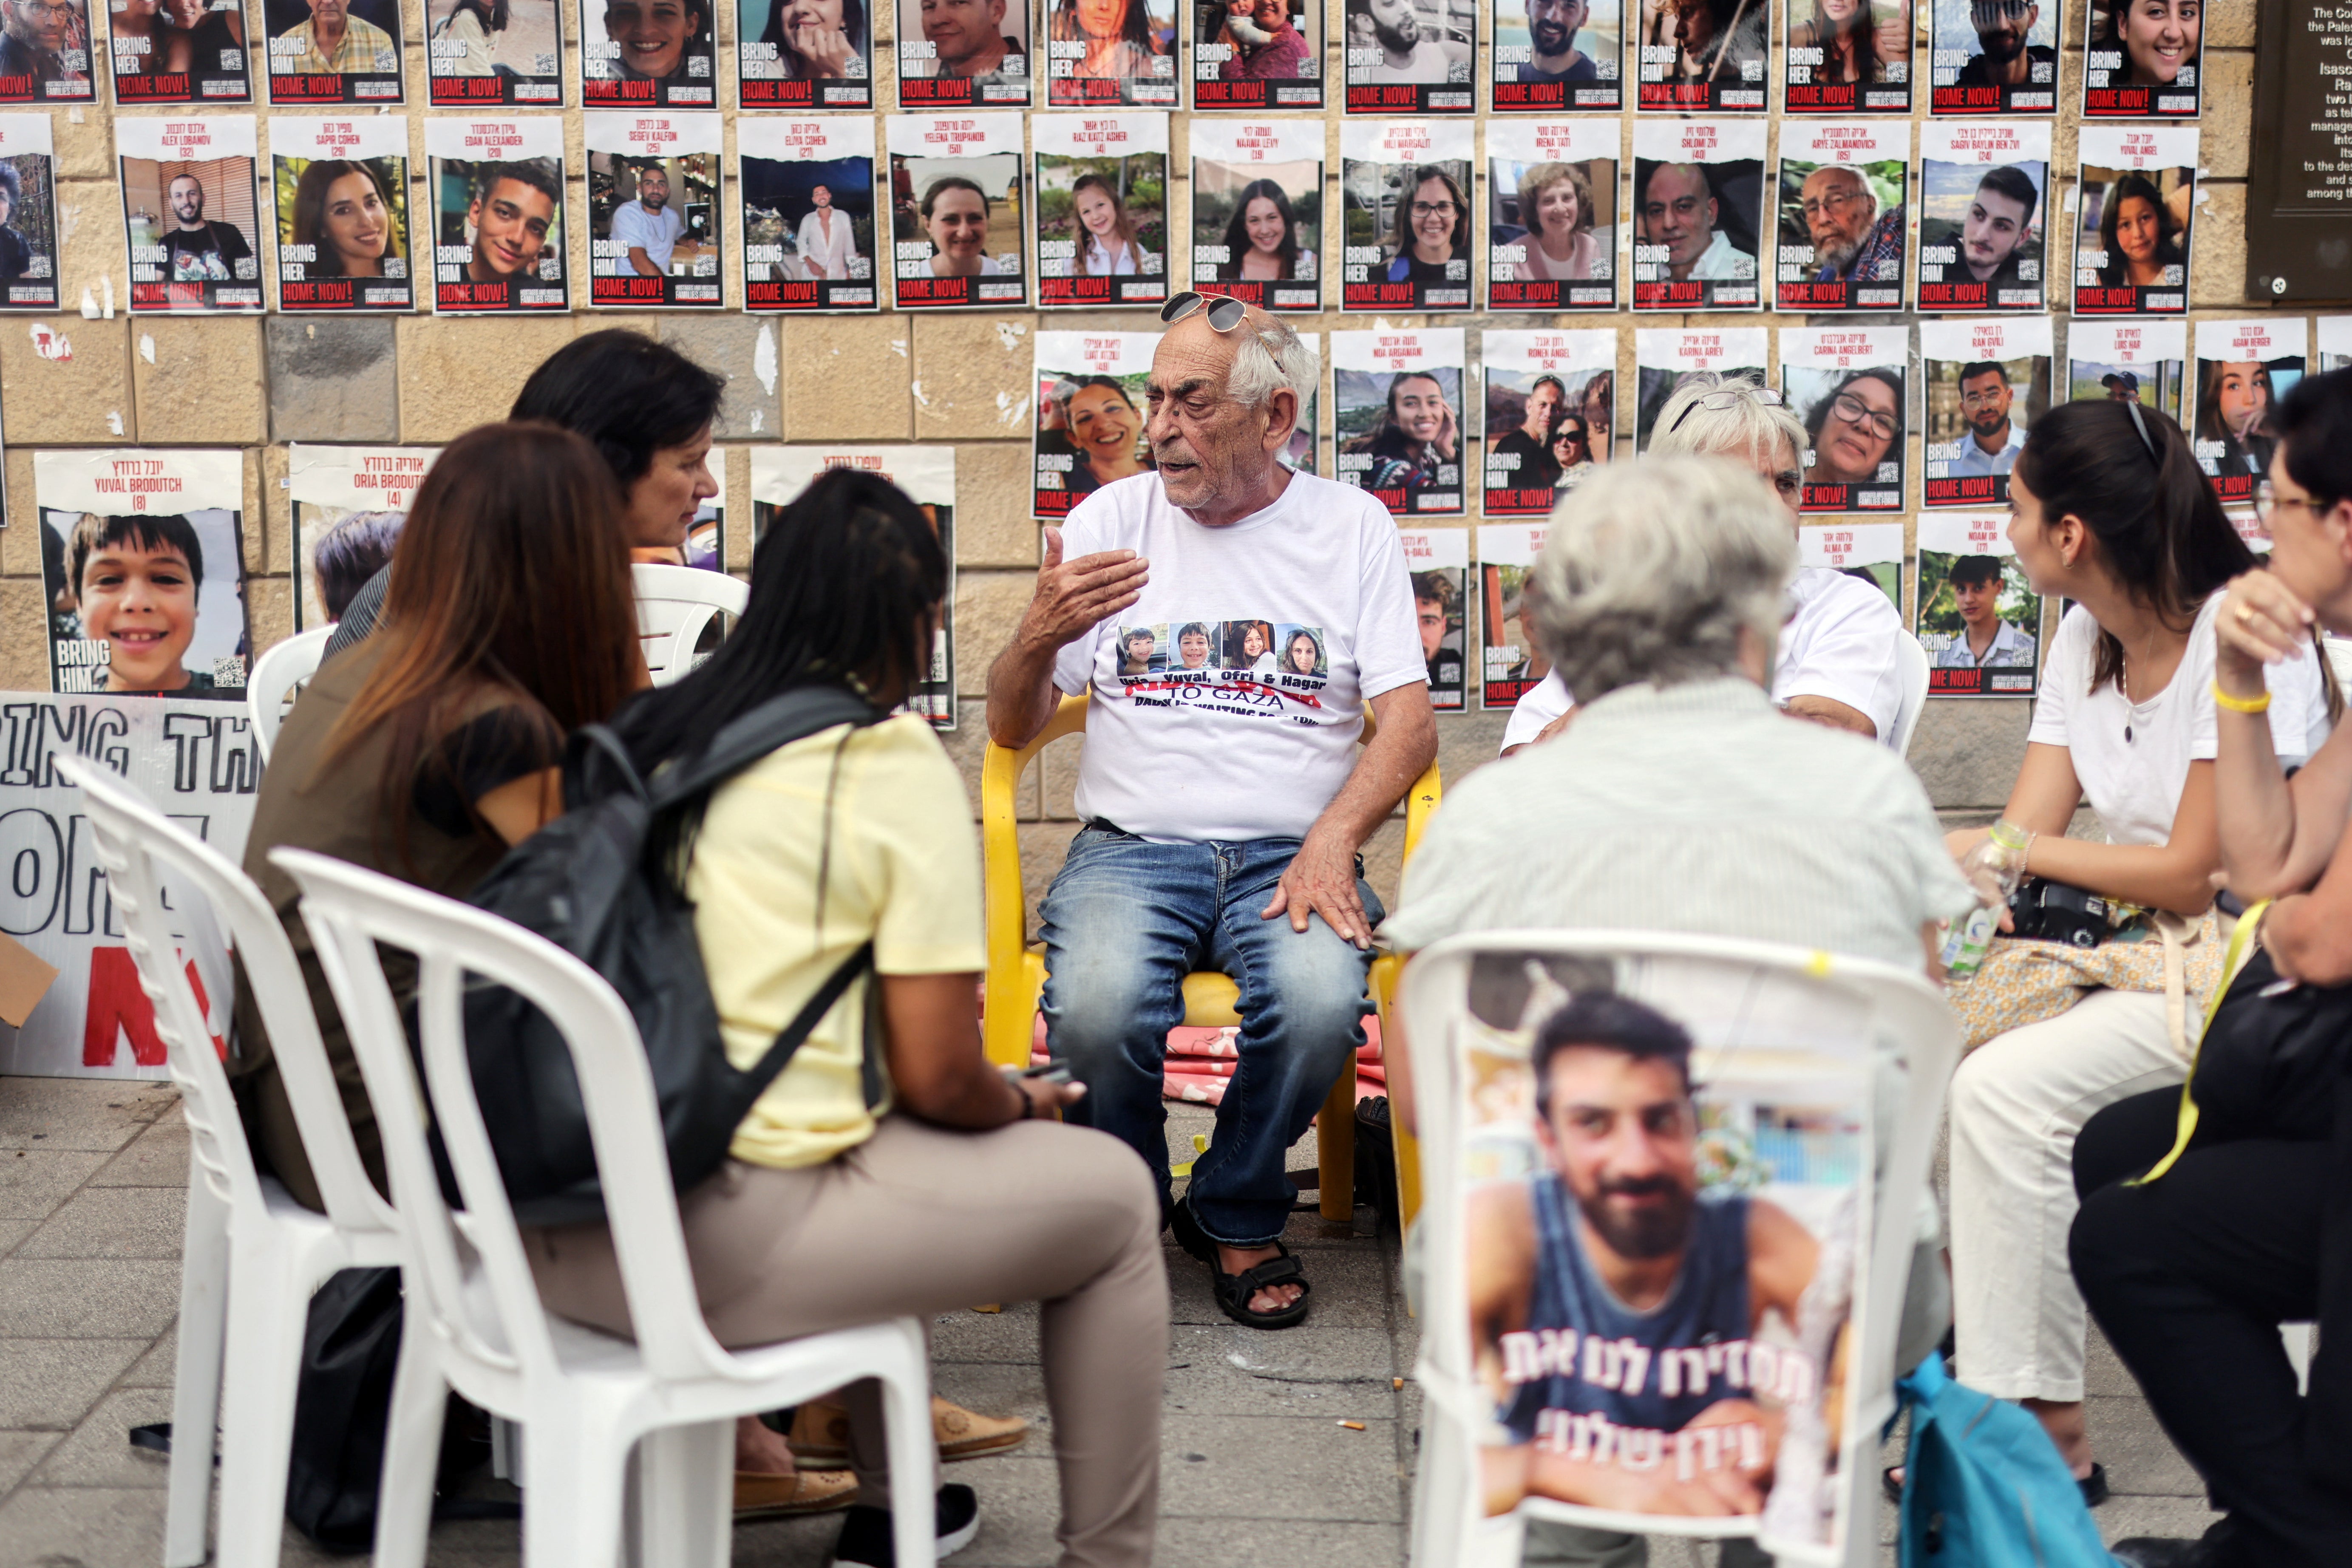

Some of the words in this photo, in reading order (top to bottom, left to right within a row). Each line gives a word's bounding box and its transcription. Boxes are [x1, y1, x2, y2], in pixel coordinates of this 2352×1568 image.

[2313, 7, 2333, 18] The
[2308, 21, 2325, 31] the
[113, 37, 151, 55] BRING
[2321, 37, 2342, 45] was
[1348, 48, 1384, 66] BRING
[1789, 47, 1824, 65] BRING
[2090, 51, 2121, 69] BRING
[115, 56, 141, 74] HER
[1348, 67, 1371, 84] HIM
[1789, 66, 1811, 84] HER
[2088, 70, 2109, 88] HER
[118, 76, 153, 95] HOME
[155, 73, 190, 93] NOW!
[902, 80, 934, 97] HOME
[938, 77, 971, 97] NOW!
[1348, 87, 1380, 104] HOME
[1383, 84, 1417, 104] NOW!
[1788, 86, 1820, 103] HOME
[1823, 84, 1854, 103] NOW!
[2088, 90, 2117, 108] HOME
[2120, 88, 2148, 108] NOW!
[2326, 94, 2346, 104] two
[2325, 109, 2338, 118] as
[1536, 138, 1555, 147] IRENA
[1557, 138, 1570, 147] TATI
[1682, 138, 1706, 148] SHLOMI
[1707, 138, 1717, 148] ZIV
[1812, 139, 1828, 149] ARYE
[1830, 139, 1876, 149] ZALMANOVICH
[1951, 140, 1970, 150] SAGIV
[1972, 140, 1994, 149] BAYLIN
[1995, 140, 2008, 150] BEN
[2009, 140, 2019, 149] ZVI
[1546, 149, 1561, 159] (73)
[1692, 150, 1707, 160] (40)
[1836, 150, 1851, 161] (85)
[1978, 151, 1992, 161] (24)
[2304, 161, 2315, 171] to
[2318, 160, 2335, 171] the
[2326, 174, 2346, 184] and
[2307, 190, 2343, 200] among
[437, 245, 473, 264] BRING
[1636, 245, 1669, 263] BRING
[437, 264, 461, 282] HIM
[1636, 263, 1657, 281] HIM
[438, 284, 471, 302] HOME
[474, 281, 508, 301] NOW!
[1636, 283, 1667, 300] HOME
[1670, 280, 1702, 300] NOW!
[1679, 347, 1703, 356] KARINA
[1704, 346, 1723, 356] ARIEV
[1815, 345, 1838, 355] CARINA
[1839, 345, 1873, 354] ANGELBERT
[1972, 337, 1986, 348] RAN
[1987, 337, 2003, 347] GVILI
[1528, 348, 1550, 358] RONEN
[1550, 348, 1569, 358] ANGEL
[1838, 357, 1850, 366] (51)
[1981, 349, 1996, 359] (24)
[1542, 359, 1557, 369] (54)
[1695, 359, 1708, 368] (19)
[1928, 443, 1961, 461] BRING
[2196, 441, 2225, 459] BRING
[112, 460, 142, 476] ברודץ
[144, 459, 164, 475] יובל
[363, 456, 394, 473] ברודץ
[396, 457, 424, 472] אוריה
[1487, 453, 1521, 470] BRING
[1928, 461, 1949, 478] HIM
[95, 476, 128, 493] YUVAL
[129, 478, 183, 493] BRODUTCH
[354, 473, 379, 488] ORIA
[380, 474, 426, 489] BRODUT
[1486, 471, 1508, 488] HIM
[1928, 480, 1959, 497] HOME
[1962, 476, 1994, 496] NOW!
[133, 495, 147, 511] (8)
[387, 491, 402, 507] (4)
[1487, 490, 1518, 507] HOME
[1521, 487, 1553, 507] NOW!
[1815, 485, 1847, 504] NOW!
[1968, 532, 1987, 541] NOAM
[1989, 532, 1998, 541] OR
[1824, 544, 1842, 553] ALMA
[1843, 543, 1852, 552] OR
[1976, 542, 1989, 552] (17)
[1832, 555, 1845, 564] (13)
[57, 640, 111, 665] BRING
[59, 667, 92, 693] HIM
[1221, 671, 1254, 681] Ofri
[1264, 674, 1275, 684] &
[1281, 676, 1326, 690] Hagar
[1166, 687, 1201, 699] TO
[1212, 688, 1284, 710] GAZA
[164, 713, 276, 794] TH
[1500, 1329, 1578, 1384] את
[1583, 1336, 1652, 1396] לנו
